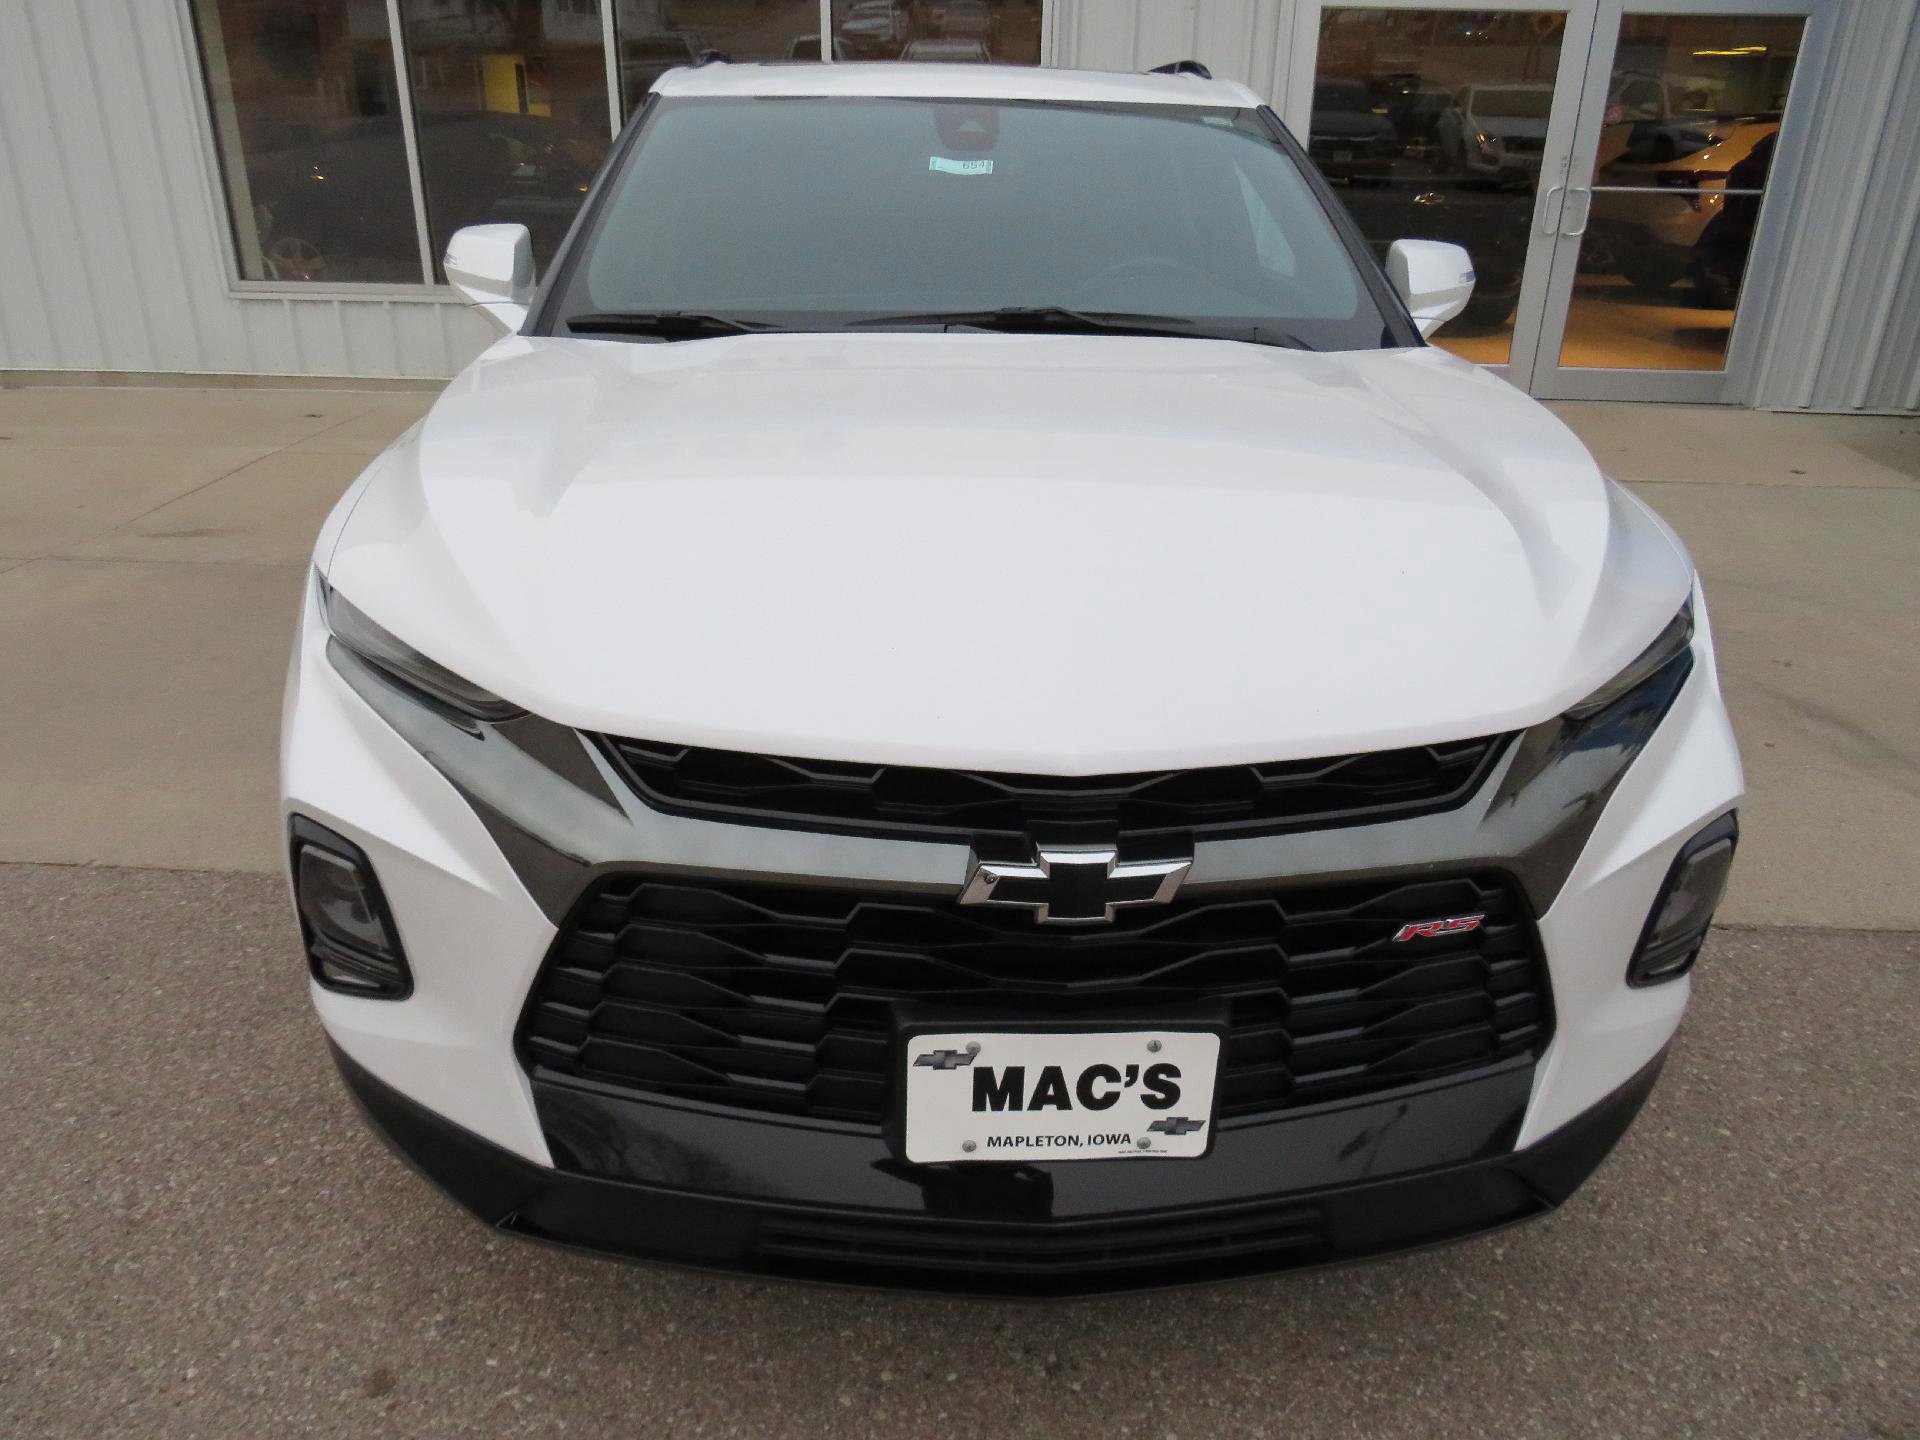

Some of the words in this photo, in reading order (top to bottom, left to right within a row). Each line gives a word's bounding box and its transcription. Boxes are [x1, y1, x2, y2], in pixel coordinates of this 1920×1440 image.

[1392, 914, 1485, 942] RS
[972, 1063, 1182, 1112] MAC'S
[987, 1134, 1084, 1147] MAPLETON,
[1087, 1133, 1131, 1145] IOWA
